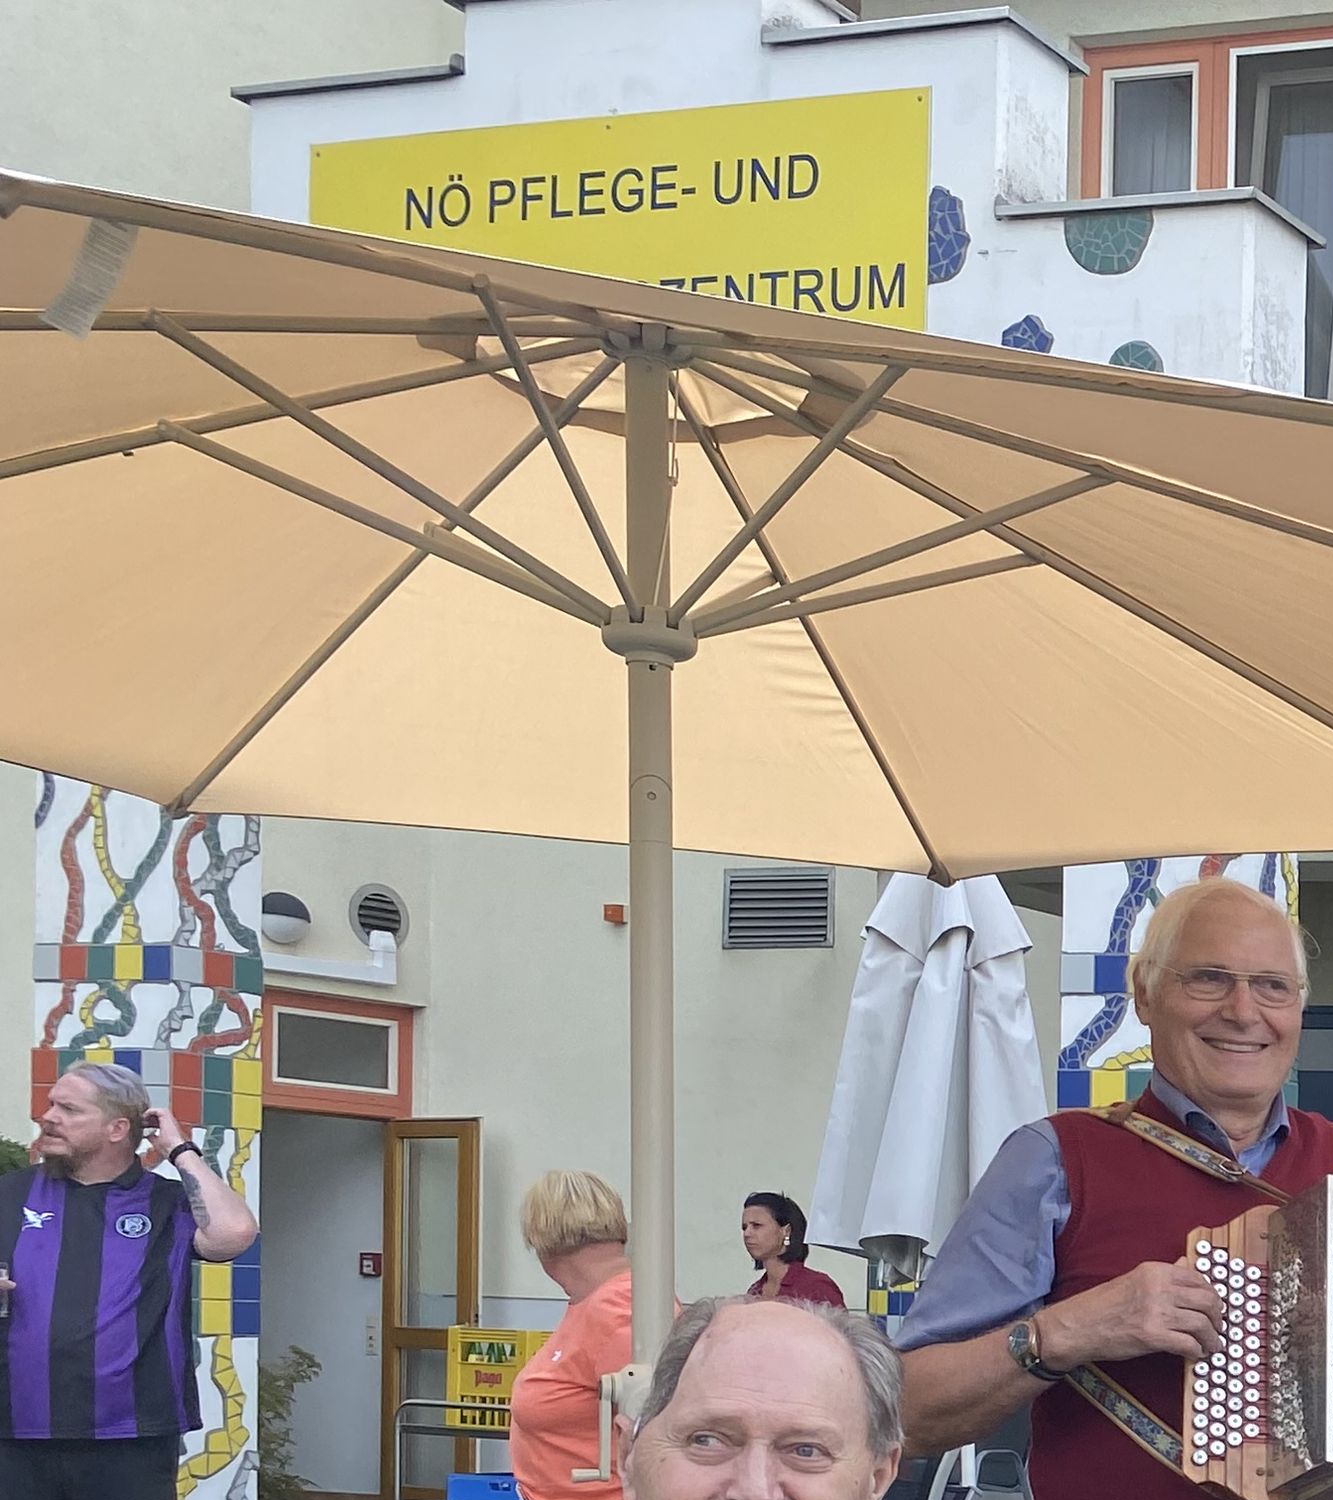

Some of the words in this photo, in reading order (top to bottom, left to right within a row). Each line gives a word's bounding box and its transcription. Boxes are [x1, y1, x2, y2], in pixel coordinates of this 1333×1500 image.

[404, 173, 471, 231] NÖ
[488, 164, 697, 225] PFLEGE-
[713, 153, 820, 204] UND
[659, 262, 906, 313] NTRUM
